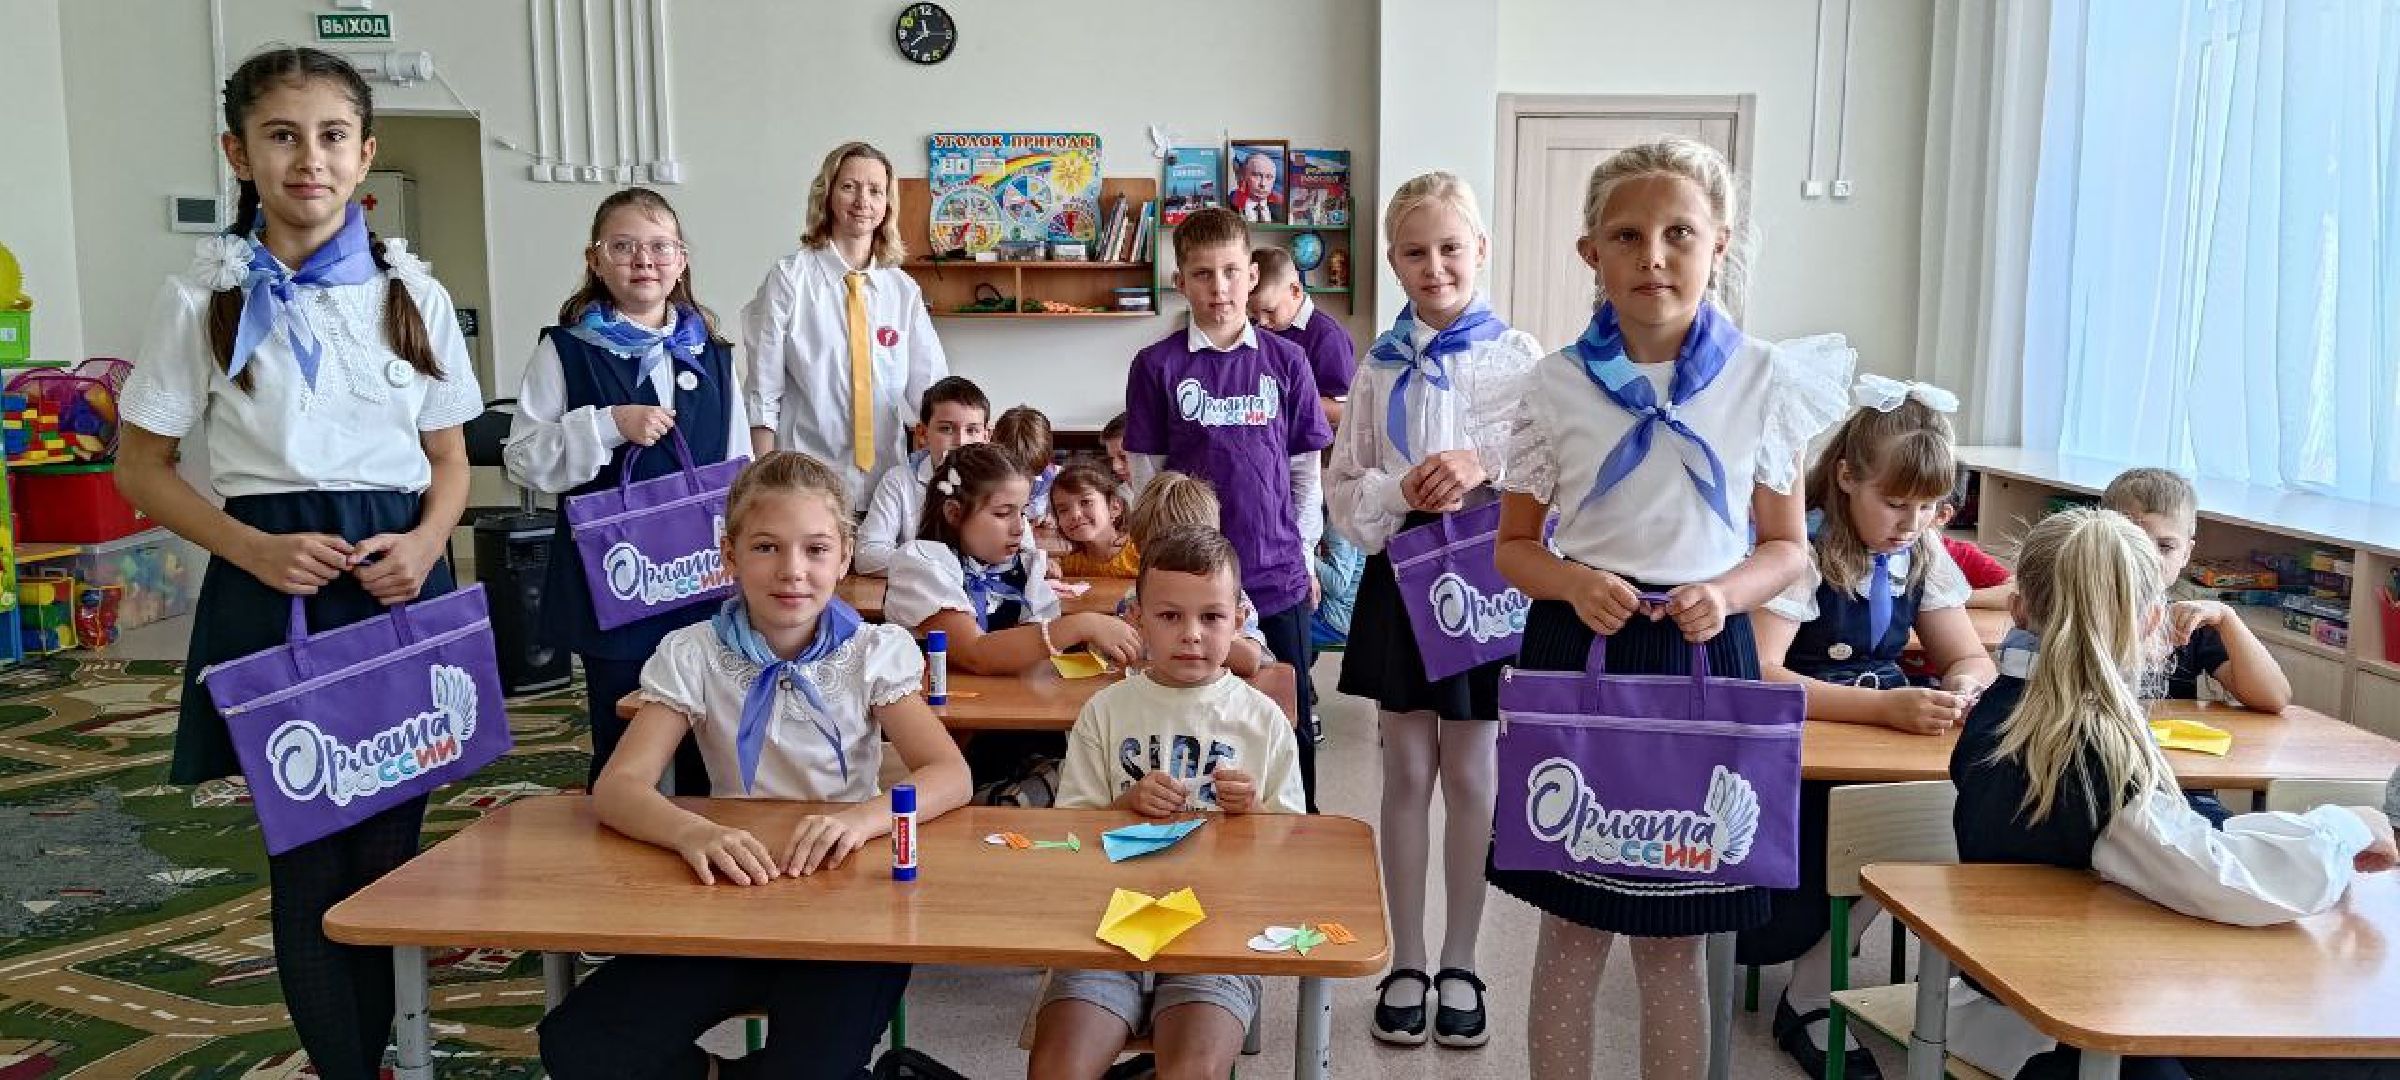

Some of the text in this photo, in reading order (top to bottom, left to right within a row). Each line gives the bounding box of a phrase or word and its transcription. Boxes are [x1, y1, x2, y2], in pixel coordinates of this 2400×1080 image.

[322, 18, 387, 36] ВЫХОД
[935, 135, 1097, 148] УГОЛОК ПРИРОДЫ
[1433, 575, 1532, 634] Орля
[271, 713, 453, 797] Орлята
[1531, 762, 1717, 848] Орлята
